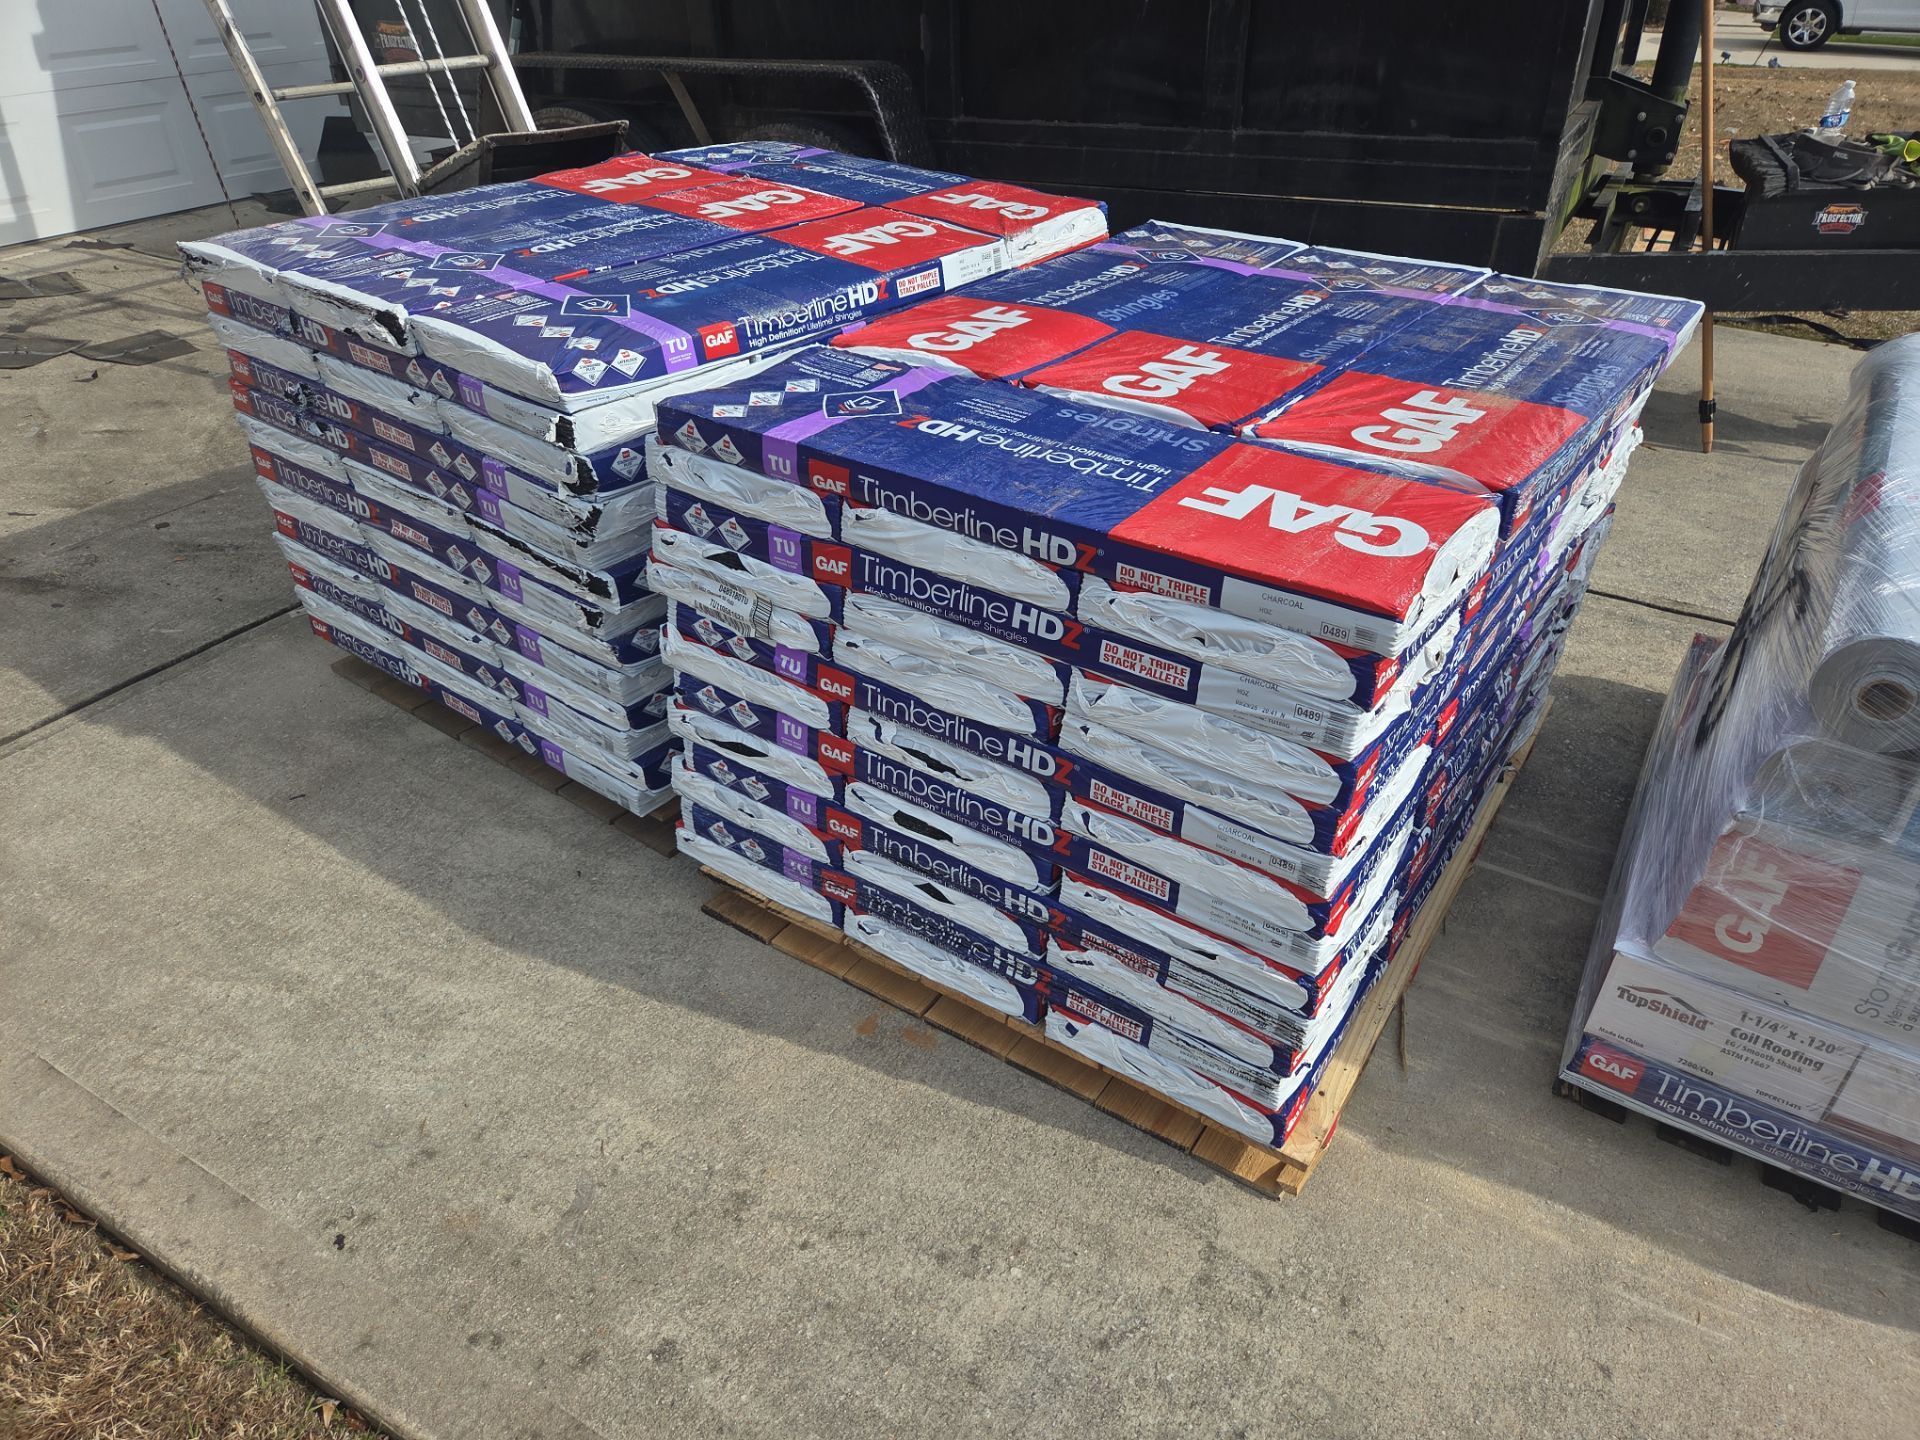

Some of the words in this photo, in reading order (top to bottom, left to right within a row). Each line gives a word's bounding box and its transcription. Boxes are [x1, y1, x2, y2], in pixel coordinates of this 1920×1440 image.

[580, 167, 692, 194] GAF
[698, 190, 806, 219] GAF
[928, 192, 1049, 220] GAF
[1817, 213, 1863, 224] PROSPECTOR
[819, 221, 938, 256] GAF
[899, 285, 917, 296] STACK
[918, 278, 939, 292] PALLETS
[908, 274, 919, 286] NOT
[919, 270, 938, 282] TRIPLE
[207, 291, 223, 305] GAF
[1096, 289, 1179, 322] Shingles
[737, 293, 848, 338] Timberline
[705, 329, 734, 348] GAF
[748, 334, 768, 349] High
[835, 309, 863, 324] Shingles
[906, 305, 1033, 351] GAF
[665, 336, 688, 354] TU
[233, 362, 250, 376] GAF
[1101, 345, 1232, 398] GAF
[232, 389, 248, 404] GAF
[462, 385, 481, 408] TU
[1056, 408, 1211, 452] Shingles
[1350, 389, 1489, 454] GAF
[767, 454, 792, 476] TU
[976, 432, 1162, 493] Timberline
[1136, 462, 1172, 476] High
[255, 456, 272, 470] GAF
[274, 458, 348, 509] Timberline
[485, 468, 503, 489] TU
[811, 474, 847, 495] GAF
[481, 500, 497, 517] TU
[857, 474, 1019, 550] Timberline
[1178, 483, 1431, 557] GAF
[773, 536, 796, 557] TU
[814, 554, 849, 576] GAF
[501, 571, 519, 591] TU
[859, 553, 1010, 623] Timberline
[1119, 565, 1135, 579] DO
[1140, 572, 1162, 585] NOT
[1167, 578, 1208, 599] TRIPLE
[1261, 591, 1305, 611] CHARCOAL
[520, 634, 537, 652] TU
[984, 621, 1028, 644] Shingles
[1322, 624, 1348, 641] 0489
[779, 654, 801, 675] TU
[1103, 653, 1136, 672] STACK
[1139, 665, 1185, 687] PALLETS
[1104, 642, 1119, 655] DO
[1123, 648, 1145, 662] NOT
[1149, 656, 1188, 678] TRIPLE
[1239, 675, 1281, 693] CHARCOAL
[1377, 661, 1400, 689] GAF
[820, 678, 852, 698] GAF
[530, 692, 545, 710] TU
[862, 682, 1004, 757] Timberline
[1296, 707, 1321, 721] 0489
[781, 719, 803, 740] TU
[544, 746, 561, 765] TU
[820, 743, 852, 764] GAF
[862, 750, 1003, 827] Timberline
[791, 795, 812, 815] TU
[867, 775, 890, 791] High
[981, 822, 1023, 847] Shingles
[1093, 791, 1124, 810] STACK
[1126, 806, 1170, 829] PALLETS
[1094, 782, 1108, 794] DO
[1111, 788, 1131, 803] NOT
[1135, 800, 1171, 820] TRIPLE
[829, 818, 860, 838] GAF
[1217, 823, 1256, 843] CHARCOAL
[869, 825, 1001, 902] Timberline
[1092, 851, 1106, 864] DO
[1109, 858, 1130, 873] NOT
[1133, 868, 1167, 889] TRIPLE
[1271, 856, 1294, 871] 0489
[824, 880, 857, 901] GAF
[1091, 861, 1122, 880] STACK
[1124, 874, 1167, 898] PALLETS
[1714, 849, 1790, 954] GAF
[1069, 1000, 1098, 1020] STACK
[1100, 1015, 1140, 1040] PALLETS
[1598, 1026, 1617, 1038] Made
[1617, 1033, 1626, 1041] in
[1625, 1036, 1645, 1049] China
[1786, 1030, 1799, 1041] x
[1719, 1047, 1745, 1062] ASTM
[1729, 1027, 1761, 1046] Coil
[1761, 1037, 1825, 1072] Roofing
[1588, 1054, 1637, 1080] GAF
[1776, 1057, 1804, 1074] Shank
[1655, 1069, 1860, 1173] Timberline
[1653, 1096, 1686, 1120] High
[1818, 1166, 1879, 1199] Shingles
